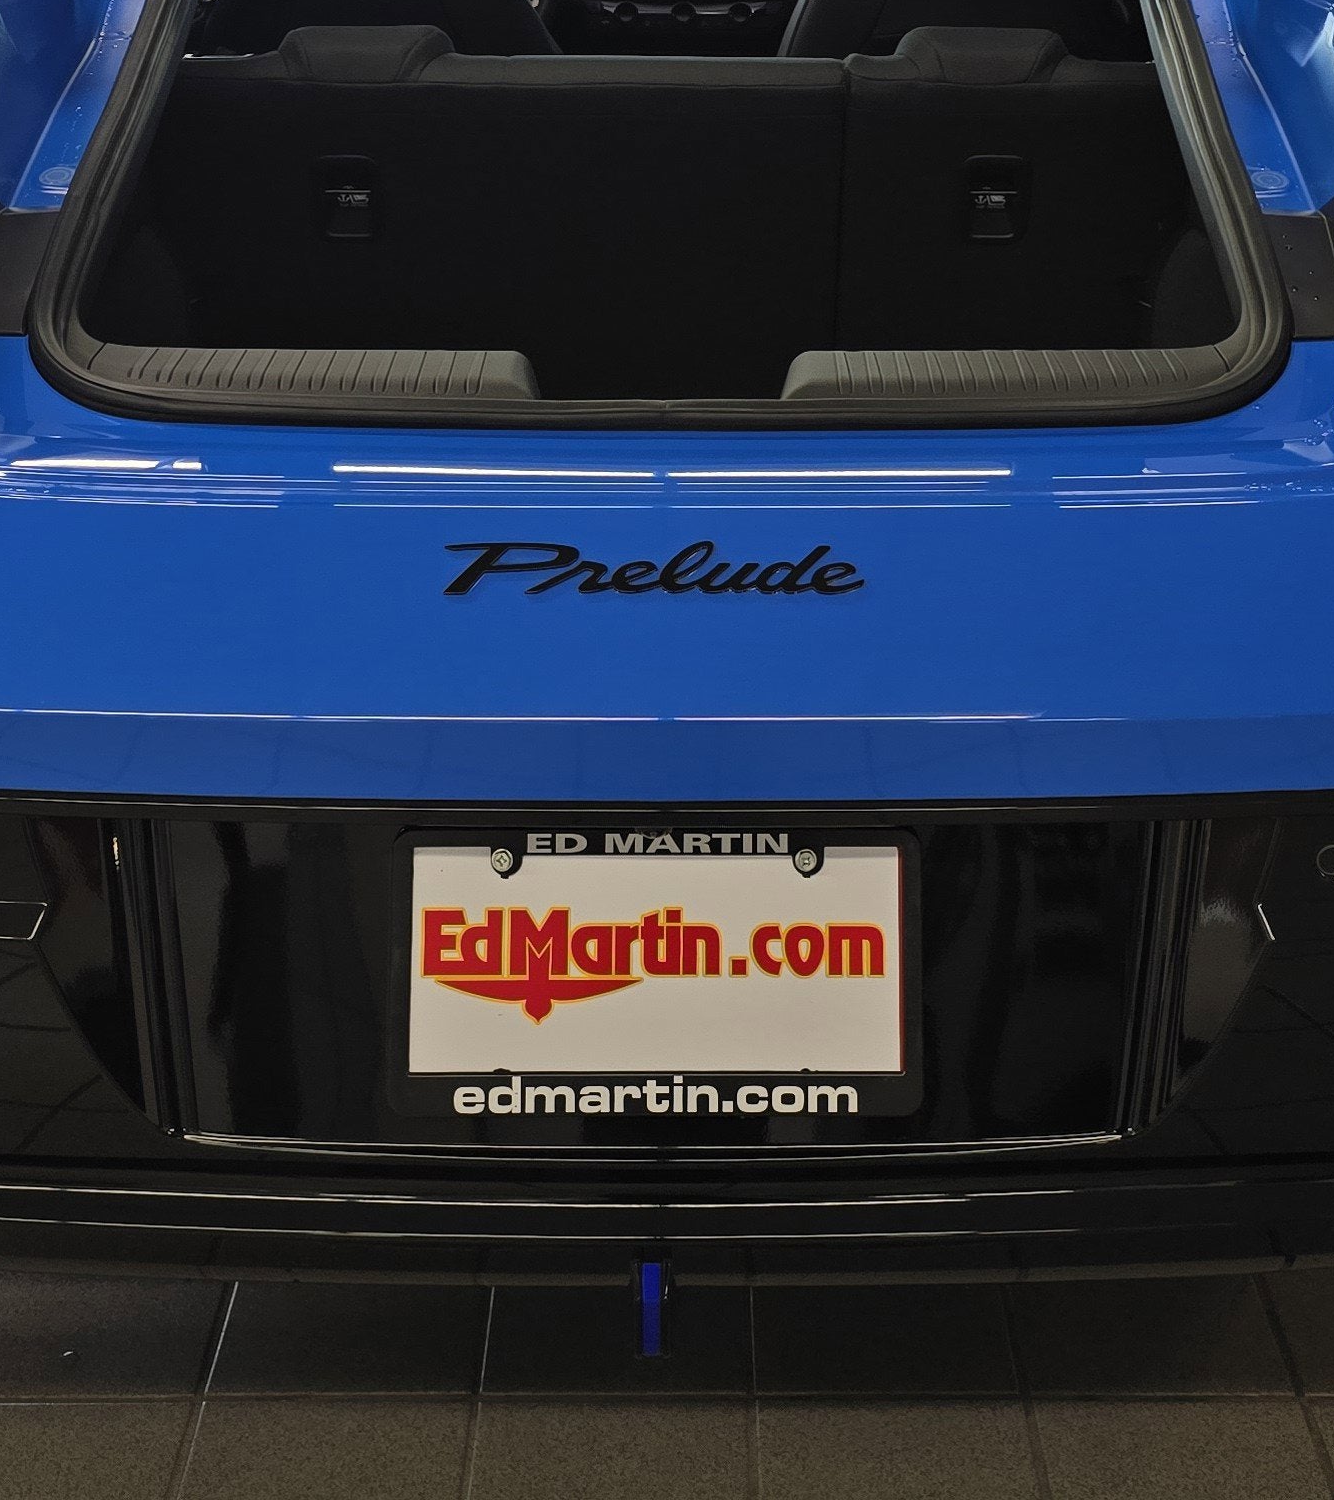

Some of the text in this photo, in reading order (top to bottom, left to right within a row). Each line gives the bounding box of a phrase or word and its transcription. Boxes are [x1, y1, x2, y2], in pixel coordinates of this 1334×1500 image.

[443, 540, 865, 596] Prelude
[526, 833, 789, 854] ED MARTIN
[421, 906, 886, 979] EdMartin.com
[453, 1075, 858, 1114] edmartin.com
